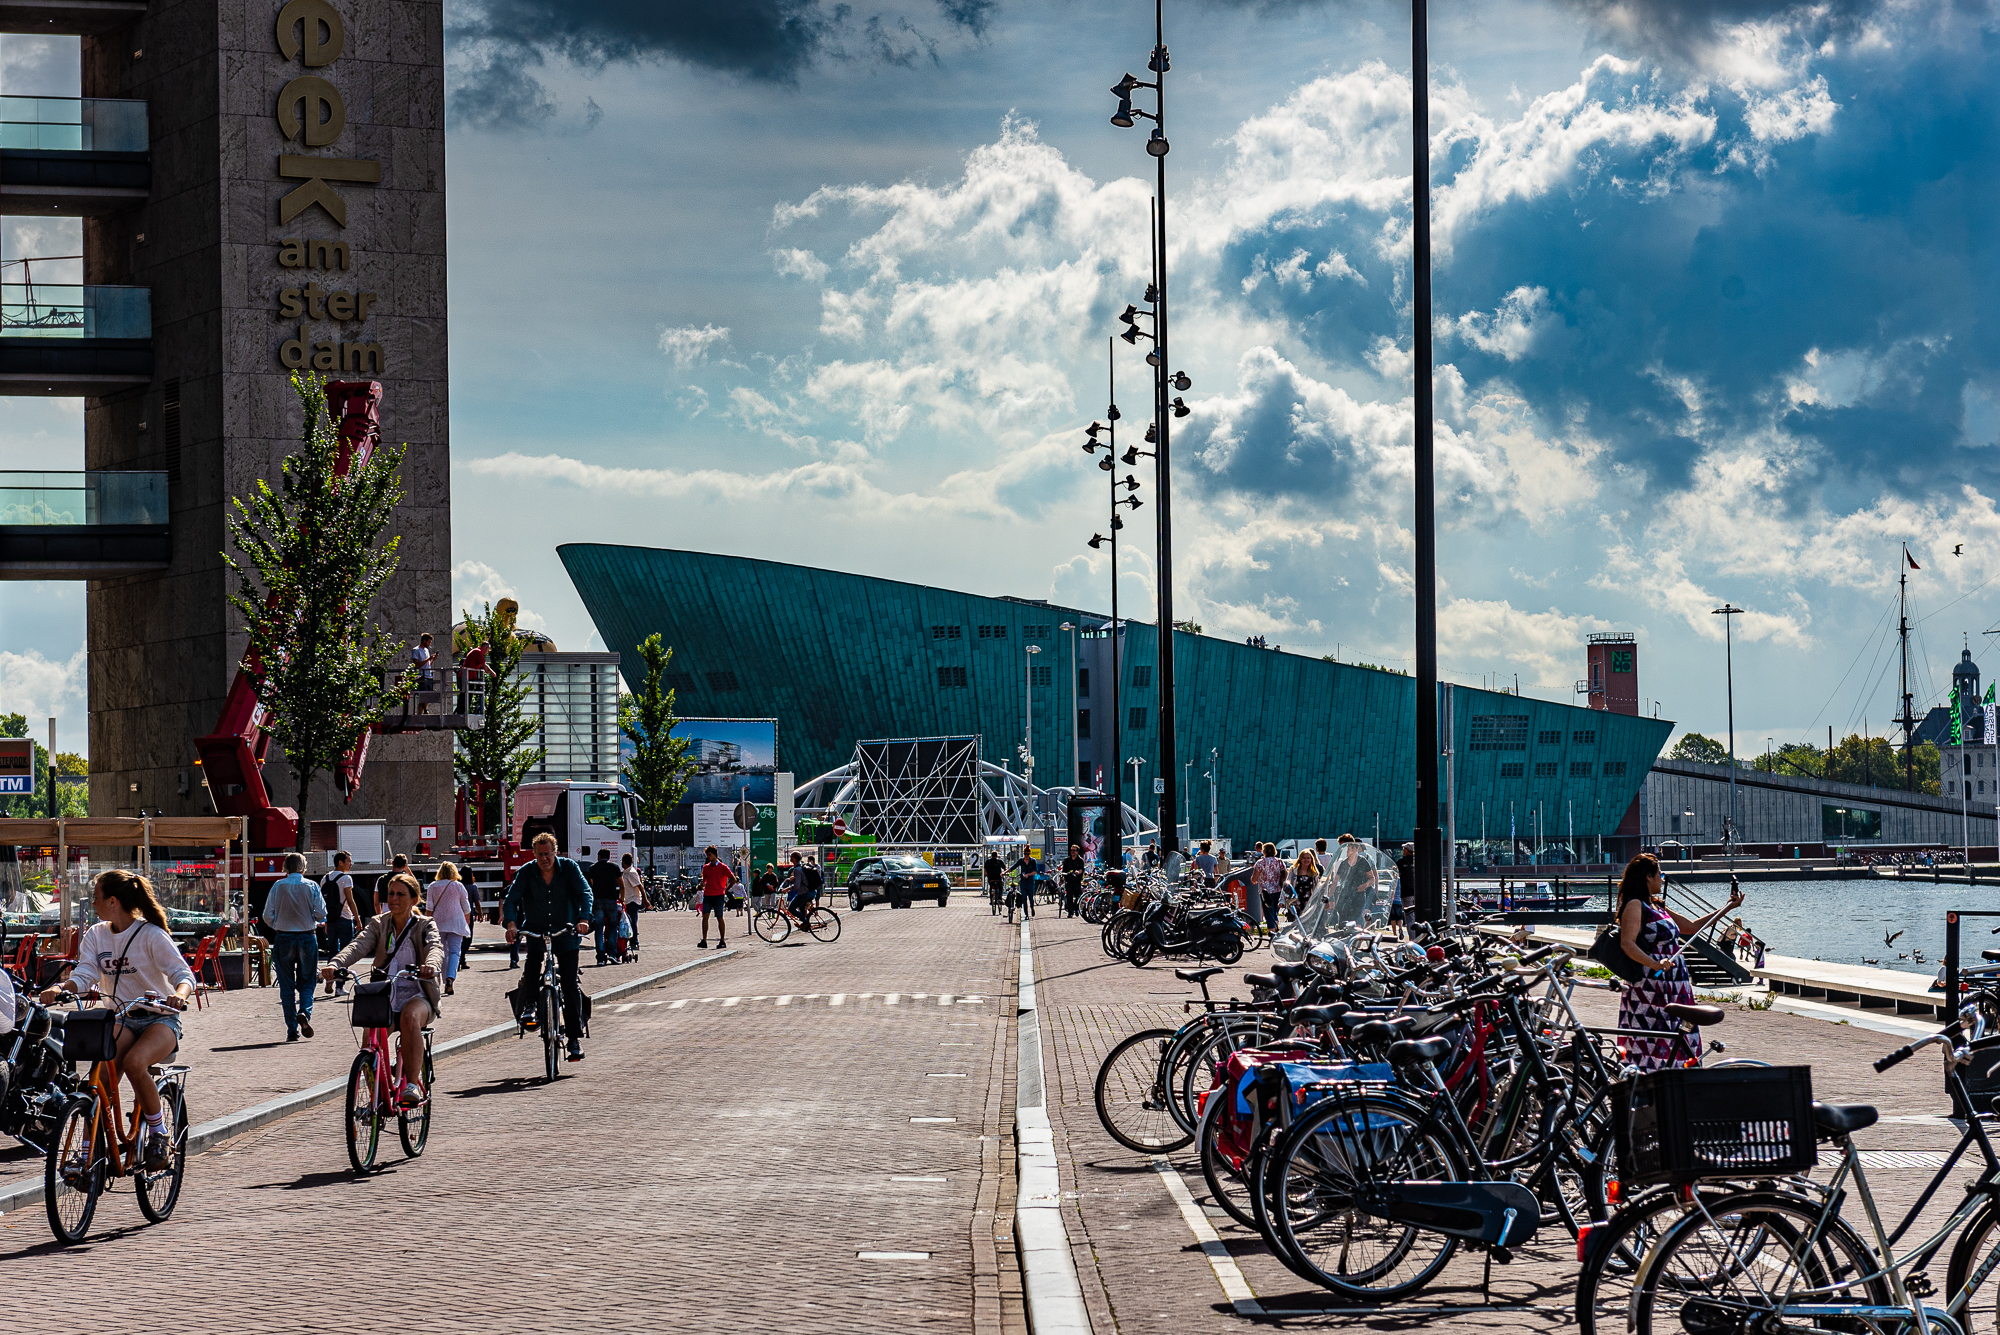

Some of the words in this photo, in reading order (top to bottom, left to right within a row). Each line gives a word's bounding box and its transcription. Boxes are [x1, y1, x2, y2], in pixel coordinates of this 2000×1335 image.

[278, 237, 350, 270] am
[279, 282, 378, 321] ster
[280, 325, 385, 372] dam
[426, 829, 432, 837] B
[658, 824, 673, 833] great
[673, 824, 688, 833] place
[971, 853, 980, 869] 2
